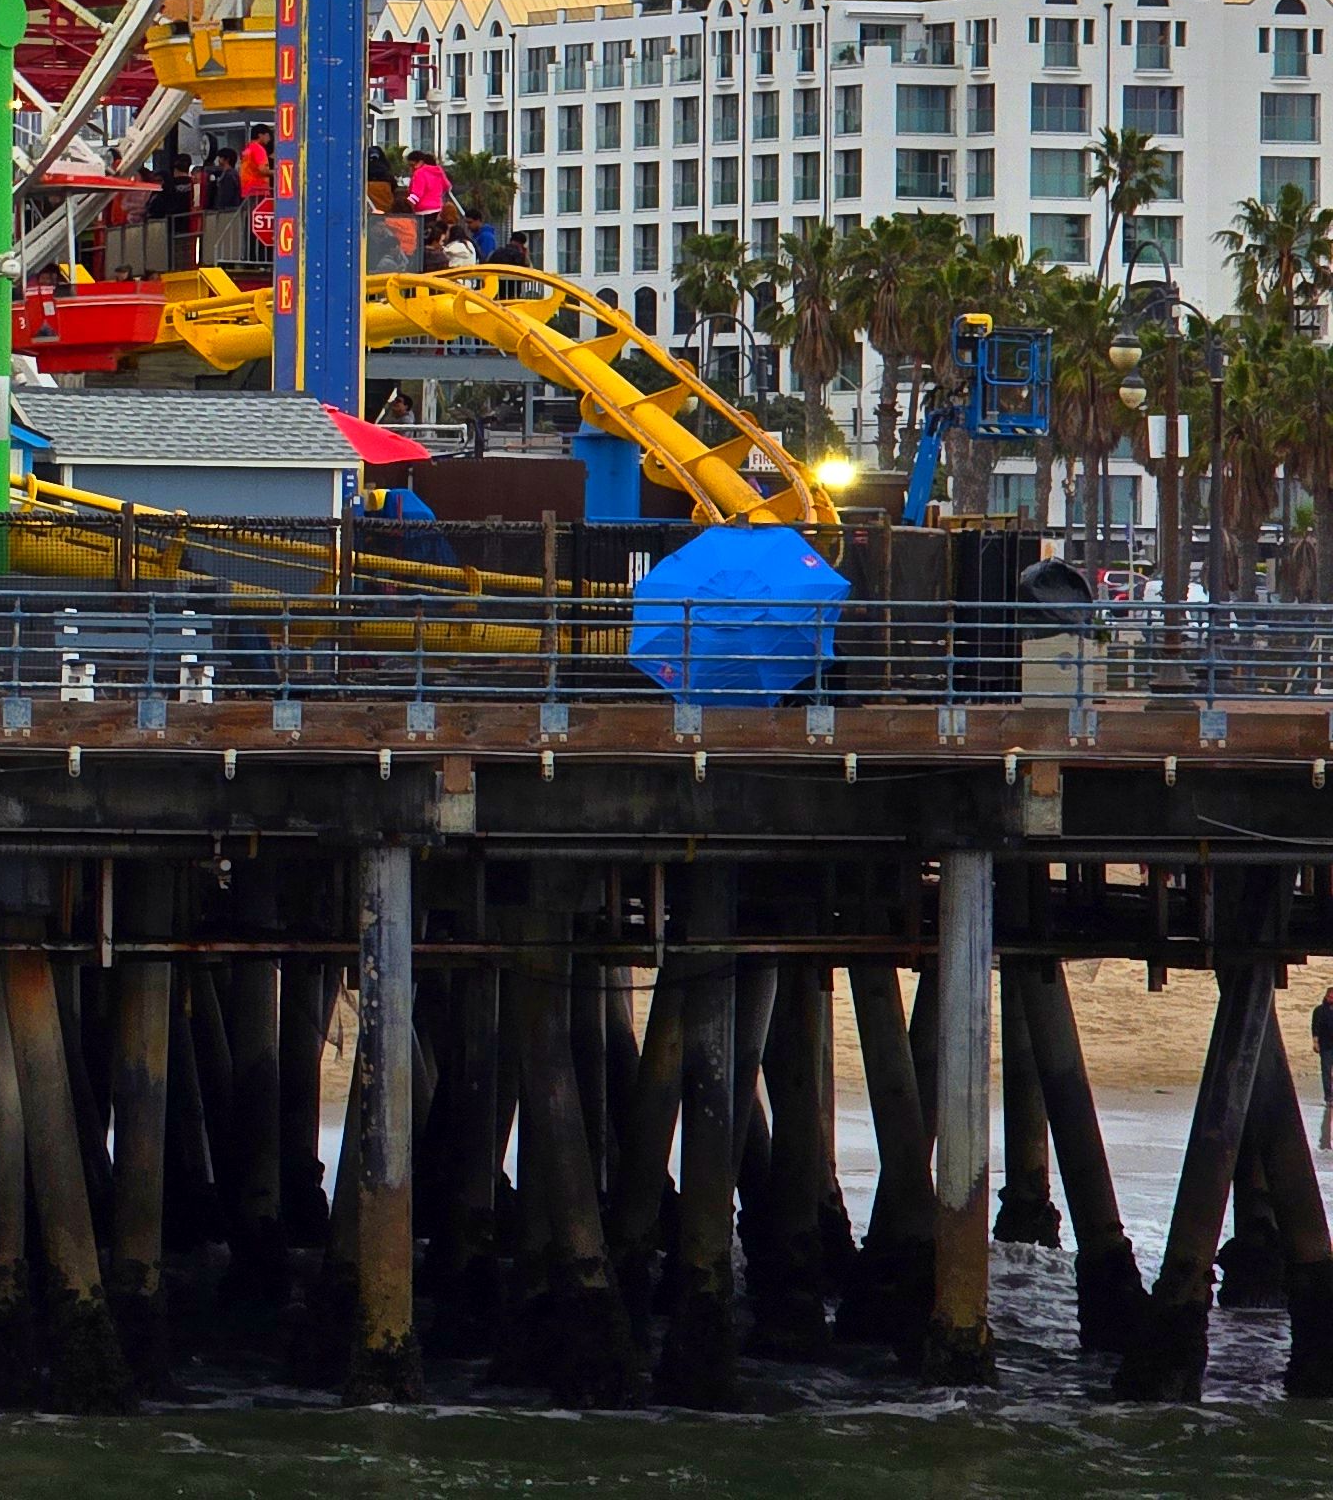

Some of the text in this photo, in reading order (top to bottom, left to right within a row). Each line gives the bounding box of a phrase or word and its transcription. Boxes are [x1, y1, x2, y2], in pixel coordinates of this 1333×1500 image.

[254, 214, 275, 229] ST
[18, 316, 26, 330] 3
[753, 453, 771, 465] FIR
